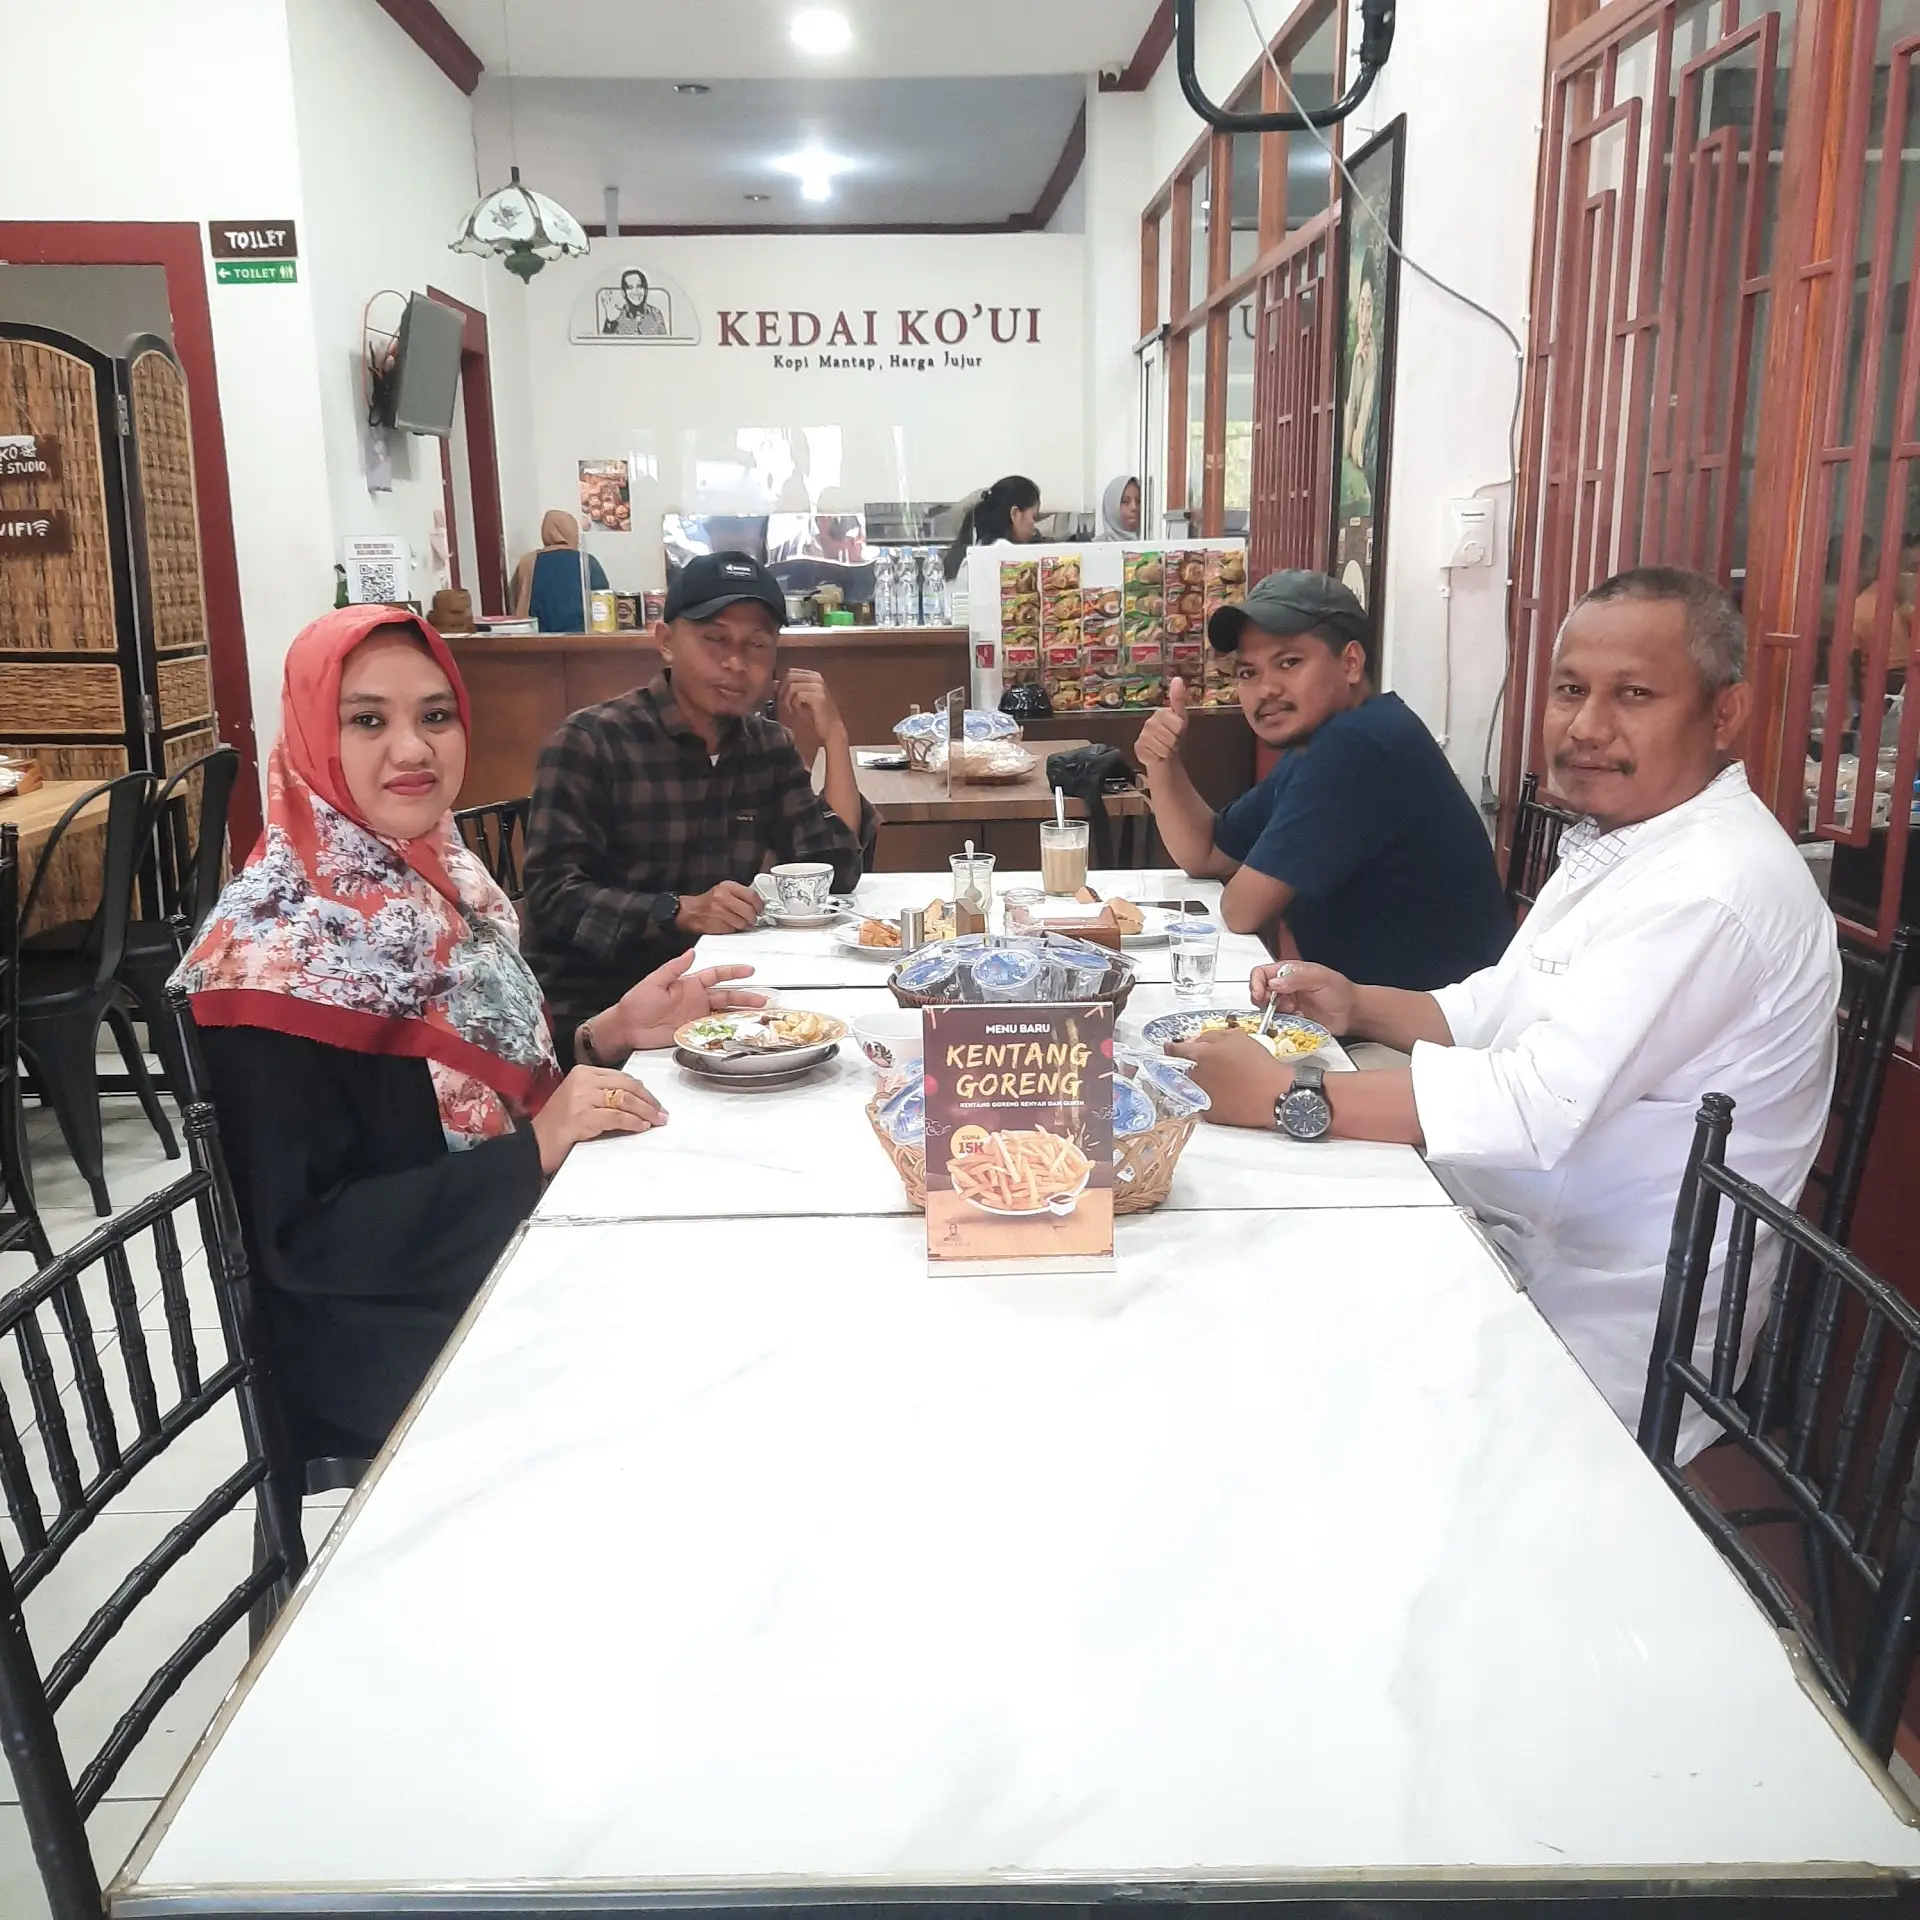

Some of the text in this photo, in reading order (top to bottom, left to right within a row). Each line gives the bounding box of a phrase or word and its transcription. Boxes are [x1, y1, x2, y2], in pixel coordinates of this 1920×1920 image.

[224, 230, 286, 249] TOILET
[233, 268, 276, 278] TOILET
[717, 310, 878, 346] KEDAI
[773, 355, 809, 371] Kopi
[889, 354, 935, 371] Harga
[944, 351, 982, 370] Jujur
[7, 461, 46, 474] STUDIO
[986, 1023, 1050, 1034] MENU BARU
[946, 1042, 1093, 1069] KENTANG
[956, 1072, 1083, 1099] GORENG
[959, 1142, 985, 1153] 15K
